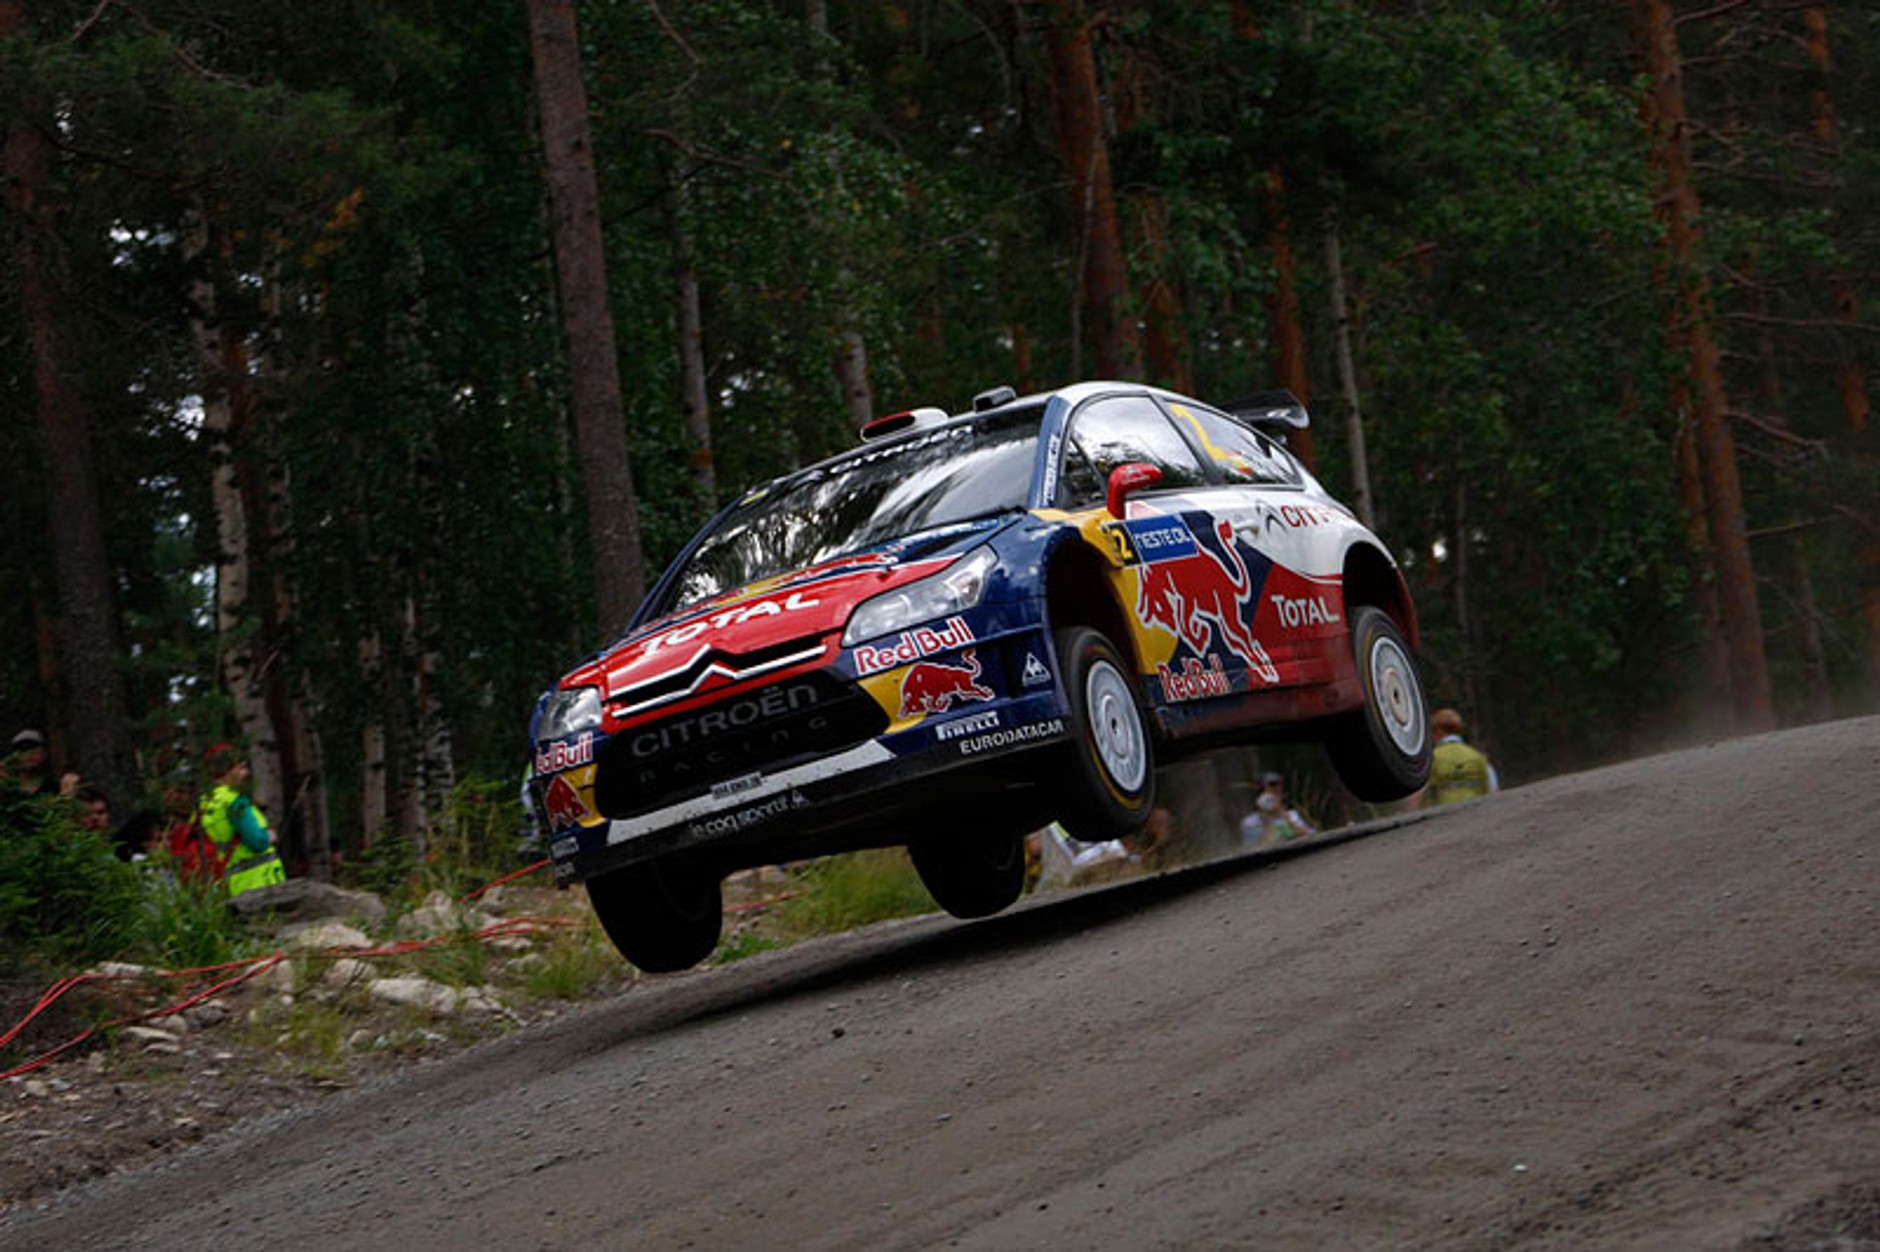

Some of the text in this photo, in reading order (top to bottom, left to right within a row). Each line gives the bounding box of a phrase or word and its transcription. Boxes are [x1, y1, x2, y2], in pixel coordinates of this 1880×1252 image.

[1133, 528, 1175, 549] NESTE
[637, 593, 819, 658] TOTAL
[1272, 594, 1340, 628] TOTAL
[854, 616, 976, 676] Red Bull
[1157, 653, 1230, 701] Red Bull
[935, 711, 1000, 740] PIRELLI
[960, 718, 1064, 754] EURODATACAR
[550, 731, 593, 769] Bull
